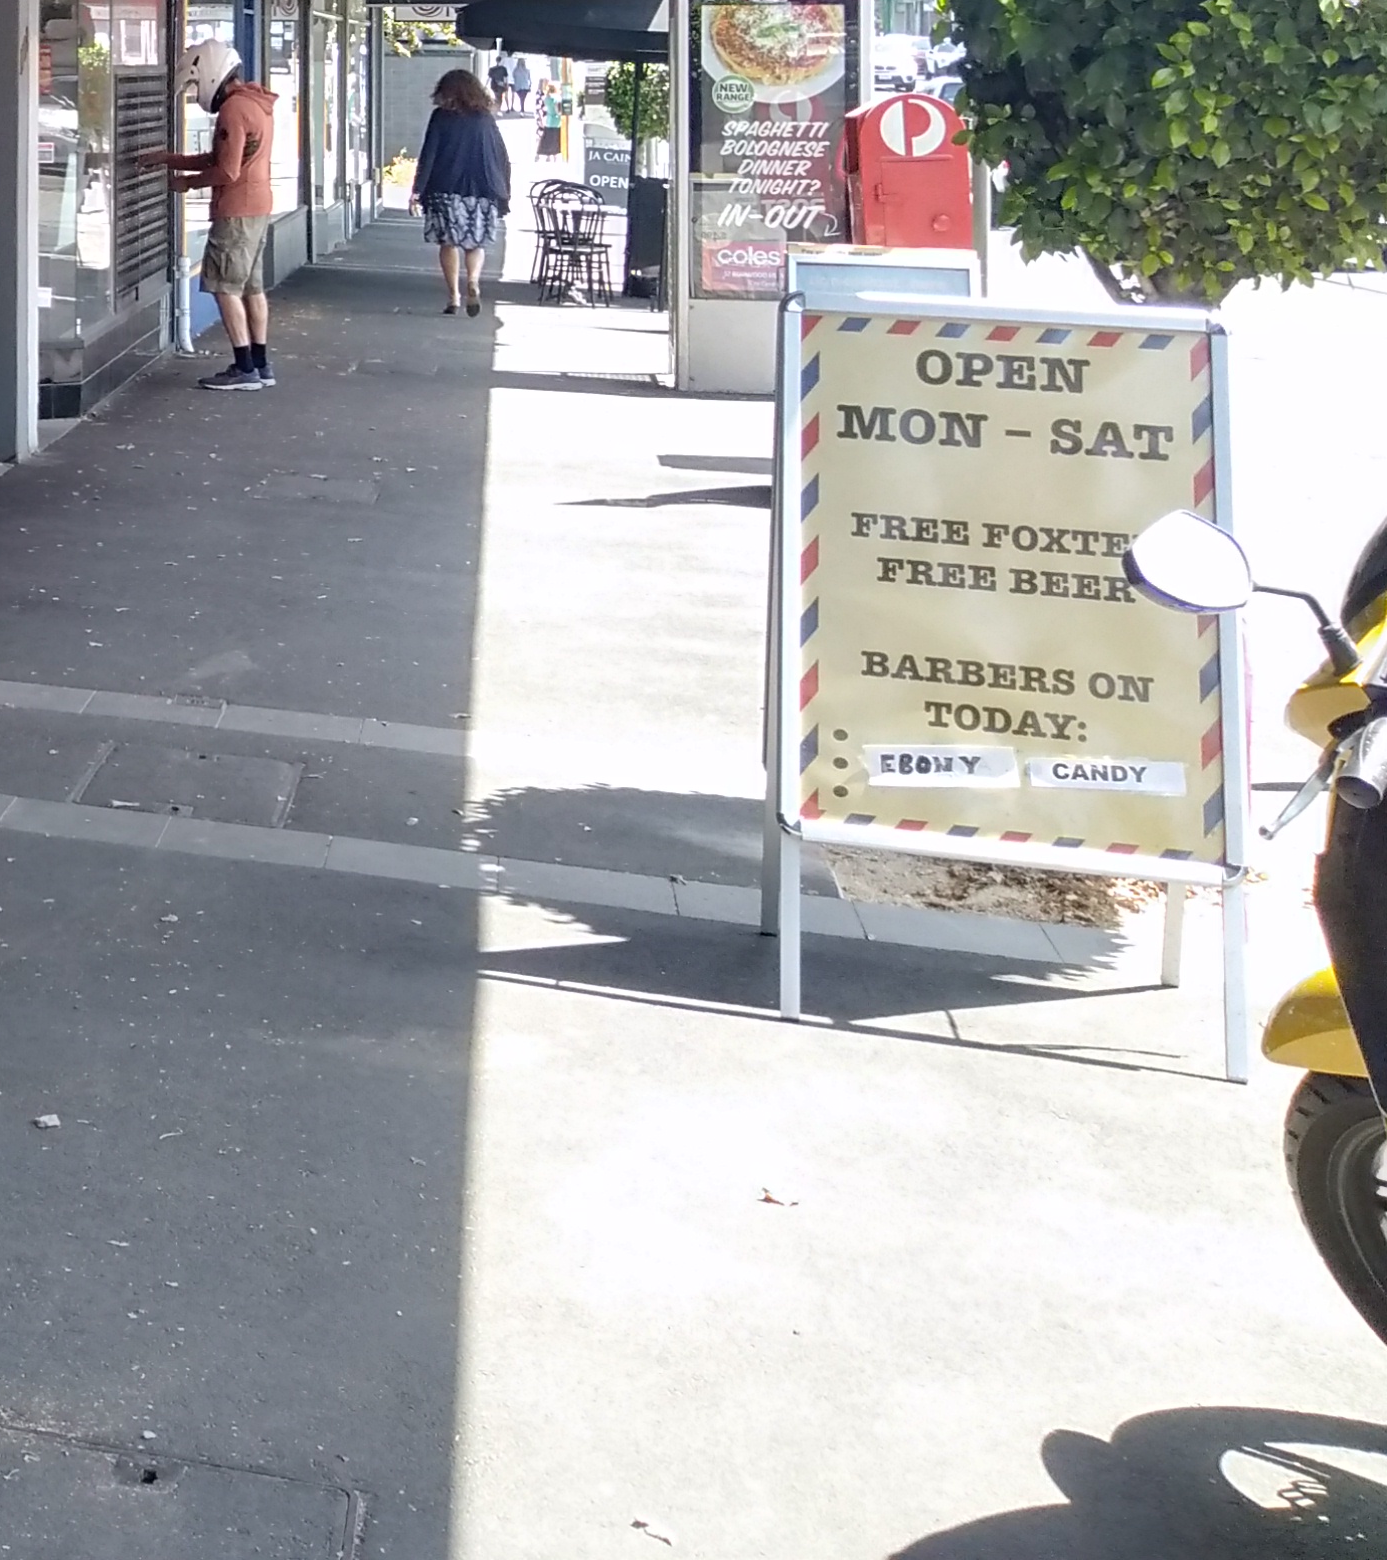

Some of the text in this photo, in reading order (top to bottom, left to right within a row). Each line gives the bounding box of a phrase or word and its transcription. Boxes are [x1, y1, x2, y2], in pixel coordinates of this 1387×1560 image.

[716, 93, 751, 102] RANGE
[719, 83, 748, 92] NEW
[721, 121, 829, 138] SPAGHETTI
[588, 150, 602, 162] JA
[720, 140, 830, 158] BOLOGNESE
[737, 159, 812, 177] DINNER
[589, 174, 629, 189] OPEN
[727, 178, 822, 196] TONIGHT?
[717, 203, 827, 230] IN-OUT
[717, 247, 780, 266] coles
[915, 348, 1090, 393] OPEN
[836, 405, 987, 448] MON
[1049, 418, 1173, 461] SAT
[851, 512, 1137, 558] FREE FOXTE
[877, 558, 1136, 604] FREE BEER
[861, 652, 1154, 702] BARBERS ON
[924, 701, 1088, 742] TODAY:
[880, 753, 982, 777] EBONY
[1052, 763, 1148, 784] CANDY
